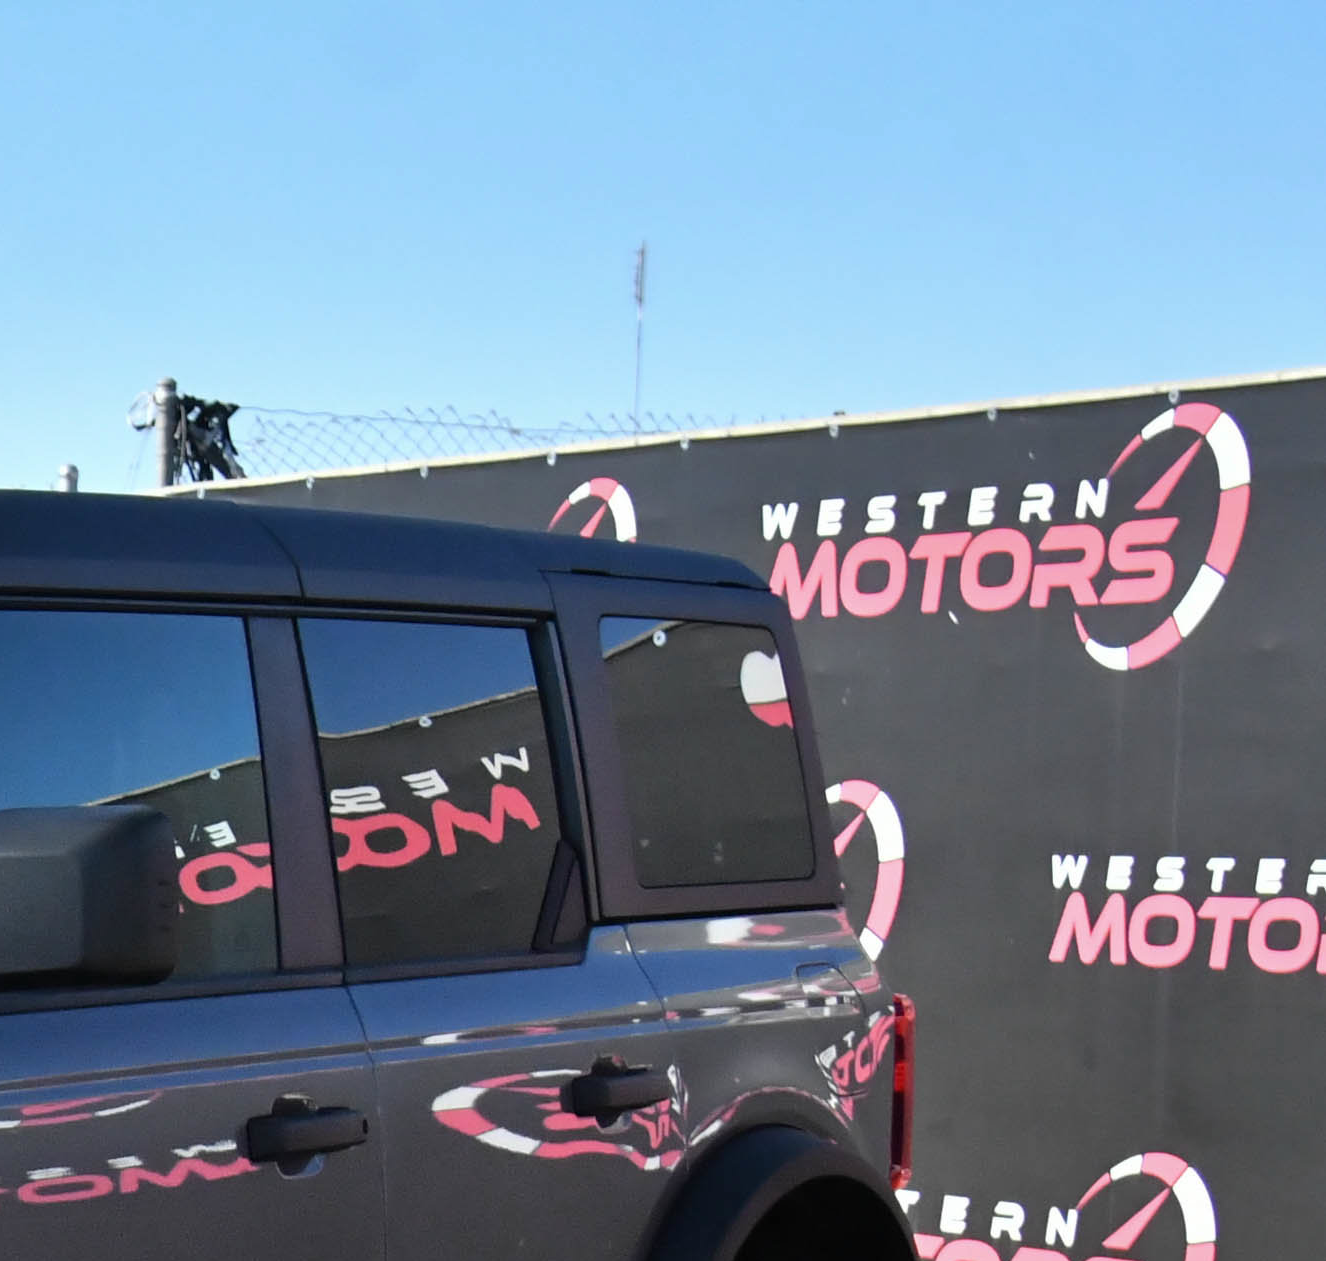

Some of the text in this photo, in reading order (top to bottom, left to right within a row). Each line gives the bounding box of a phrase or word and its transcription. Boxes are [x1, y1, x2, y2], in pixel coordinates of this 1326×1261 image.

[762, 478, 1109, 541] WESTERN
[769, 516, 1179, 620] MOTORS
[1051, 854, 1326, 895] WESTER
[1048, 891, 1326, 975] MOTO
[894, 1188, 1079, 1248] TERN
